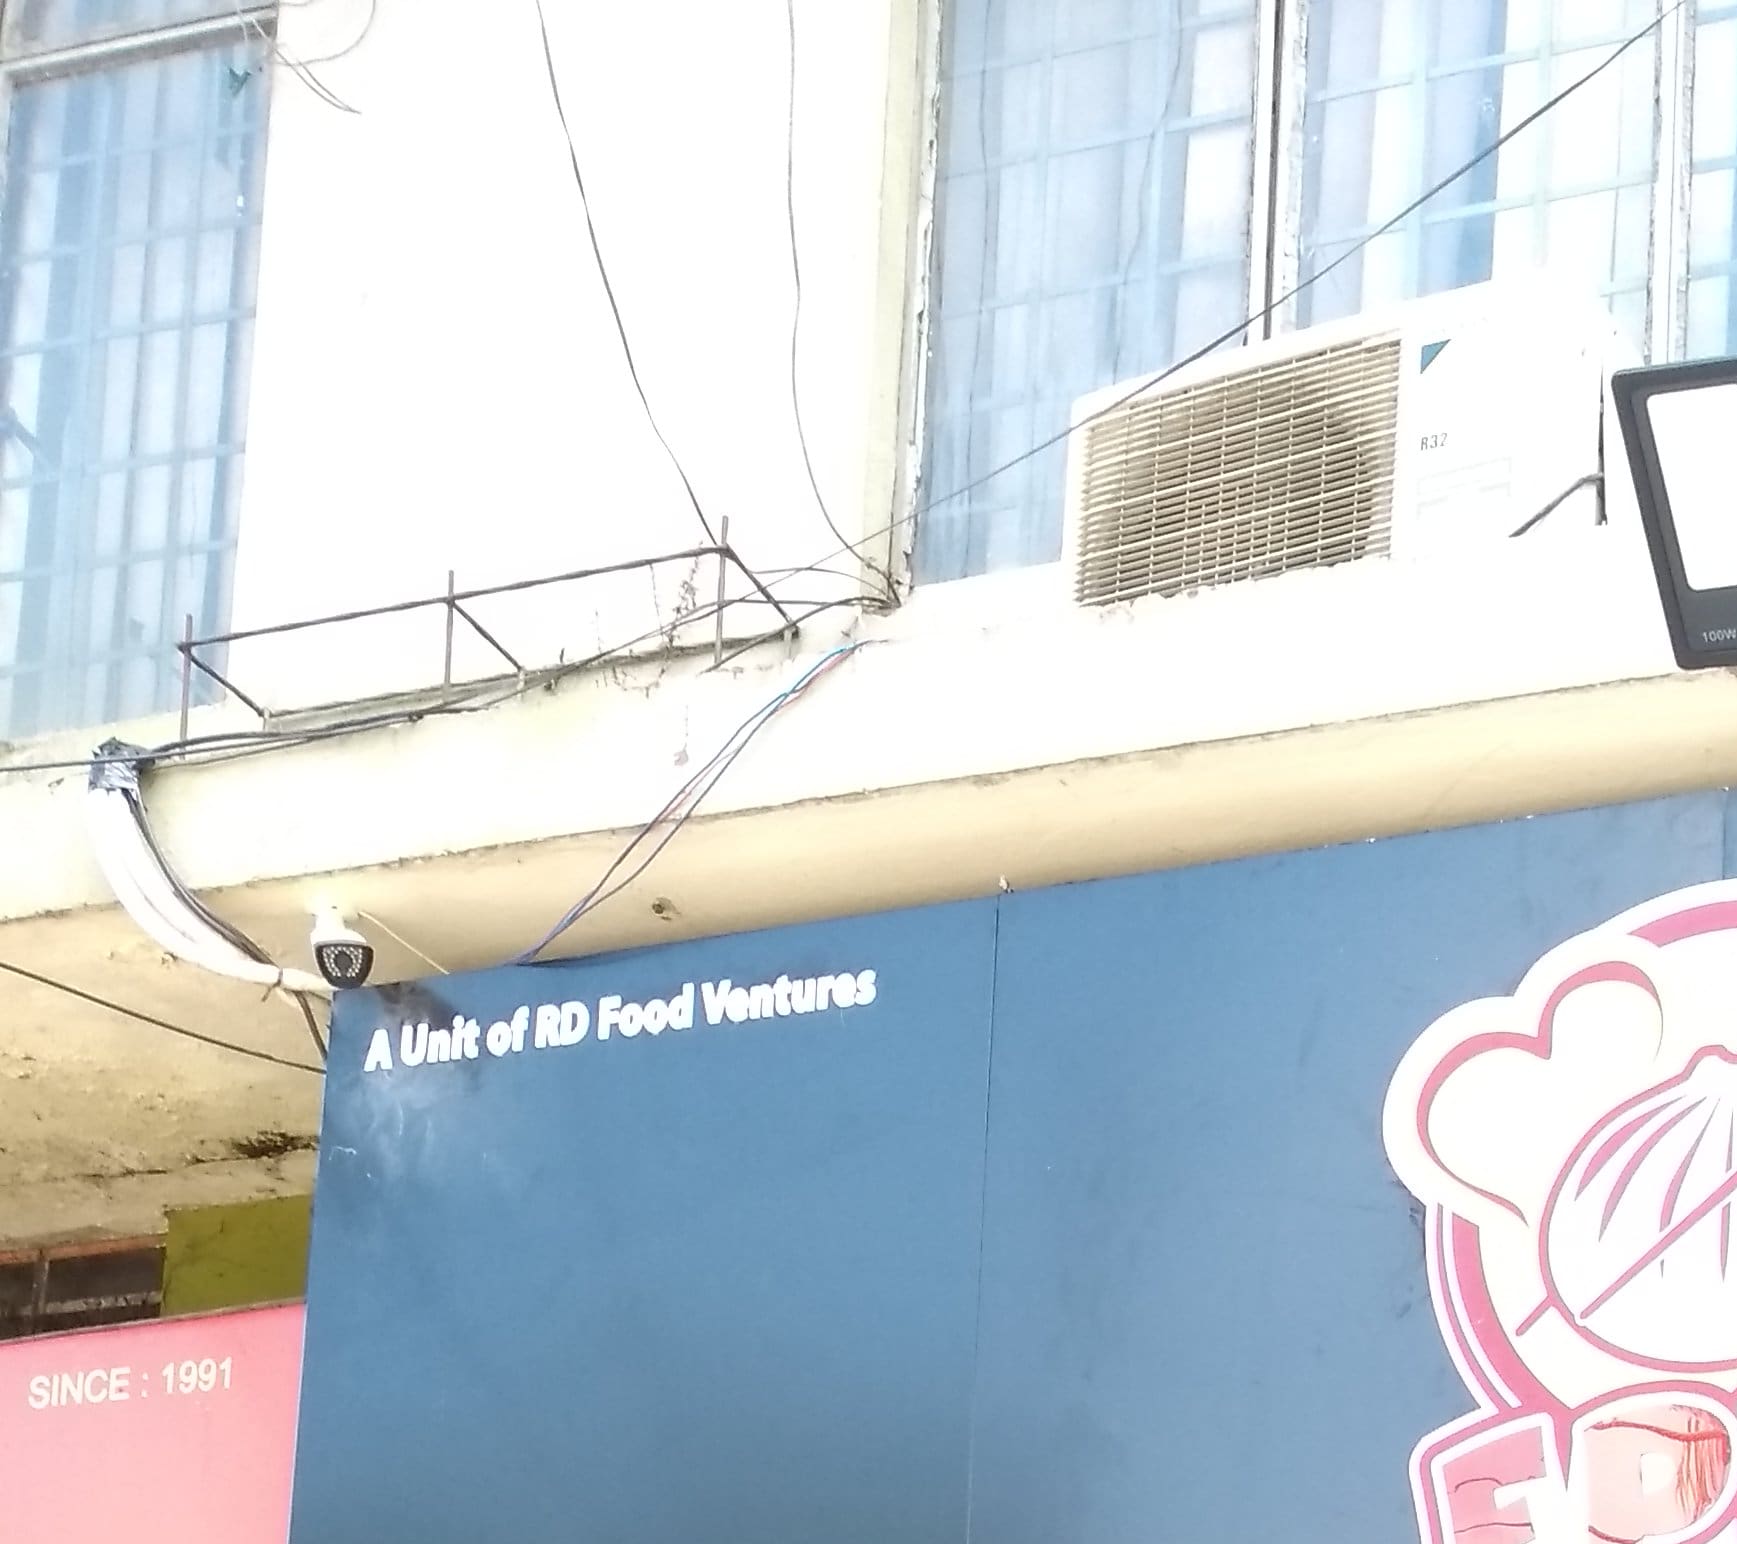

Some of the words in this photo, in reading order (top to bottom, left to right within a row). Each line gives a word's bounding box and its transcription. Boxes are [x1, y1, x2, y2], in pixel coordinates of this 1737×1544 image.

[1420, 432, 1448, 451] R32
[1701, 627, 1737, 643] 100W
[364, 1029, 393, 1072] A
[400, 1015, 481, 1067] Unit
[487, 1006, 530, 1057] of
[534, 1001, 590, 1049] RD
[598, 982, 695, 1040] Food
[701, 970, 876, 1025] Ventures
[28, 1367, 131, 1409] SINCE
[160, 1356, 233, 1396] 1991
